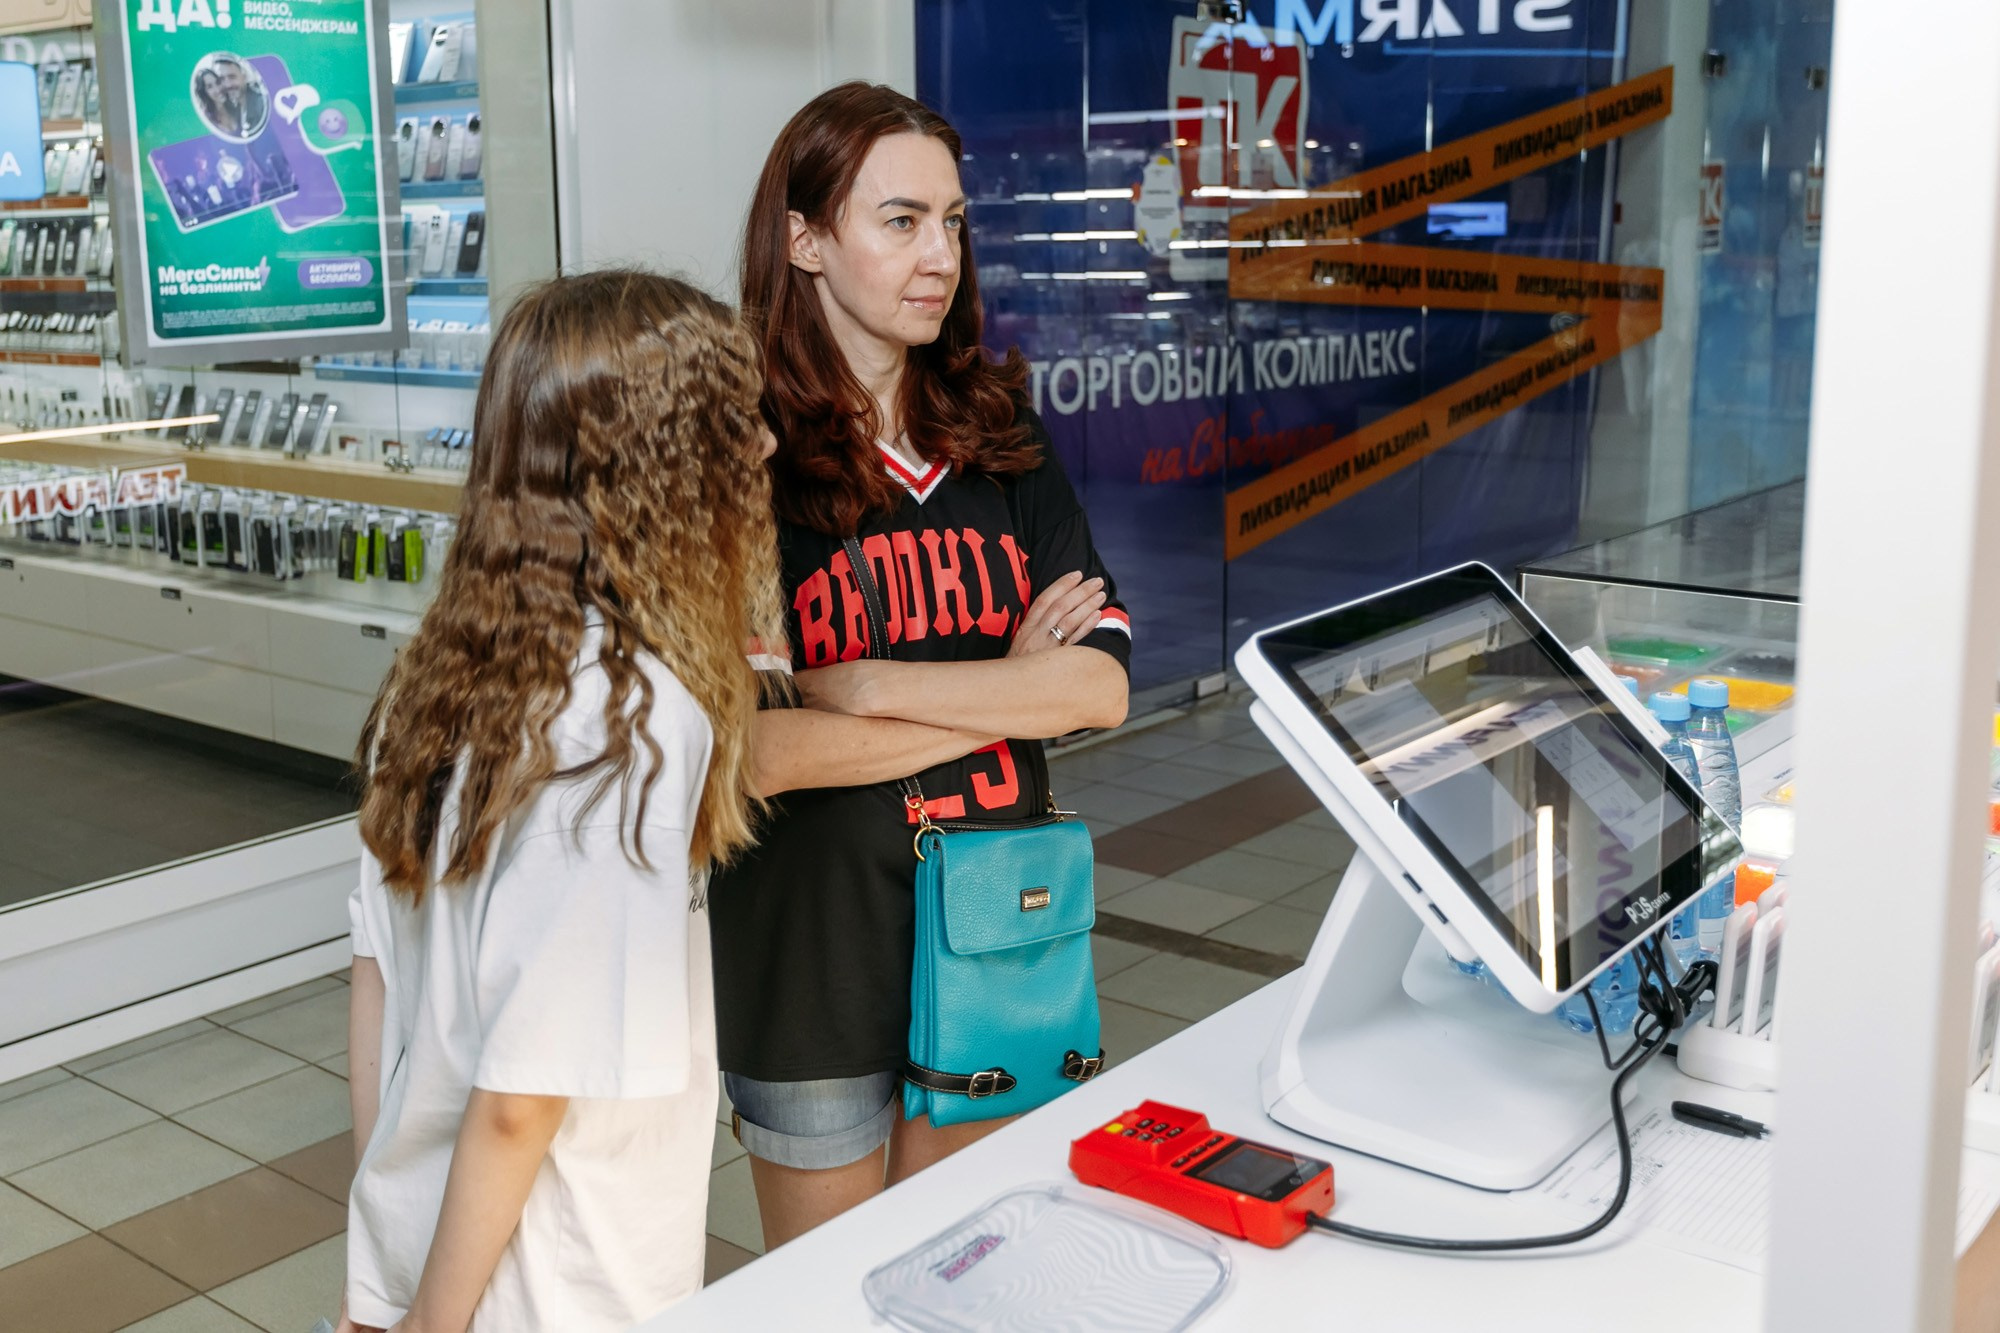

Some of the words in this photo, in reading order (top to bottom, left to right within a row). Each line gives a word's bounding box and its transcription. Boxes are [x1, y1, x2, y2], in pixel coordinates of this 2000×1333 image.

[244, 16, 358, 34] МЕССЕНДЖЕРАМ
[1240, 188, 1378, 263] ЛИКВИДАЦИЯ
[1382, 156, 1472, 211] МАГАЗИНА
[1493, 109, 1593, 170] ЛИКВИДАЦИЯ
[1595, 84, 1664, 131] МАГАЗИНА
[158, 263, 260, 284] МегаСилы
[309, 262, 361, 275] АКТИВИРУЙ
[310, 273, 362, 285] БЕСПЛАТНО
[1311, 258, 1422, 294] ЛИКВИДАЦИЯ
[1426, 267, 1498, 293] МАГАЗИНА
[1515, 273, 1600, 303] ЛИКВИДАЦИЯ
[1603, 279, 1659, 301] МАГАЗИНА
[160, 284, 178, 296] на
[180, 280, 262, 295] безлимиты
[1030, 336, 1244, 416] ТОРГОВЫЙ
[1253, 326, 1416, 391] КОМПЛЕКС
[1446, 368, 1533, 428] ЛИКВИДАЦИЯ
[1535, 336, 1596, 382] МАГАЗИНА
[1141, 446, 1184, 484] на
[1239, 457, 1352, 536] ЛИКВИДАЦИЯ
[1354, 419, 1431, 476] МАГАЗИНА
[793, 527, 1029, 668] BROOKLY
[1624, 896, 1655, 925] POS
[1650, 891, 1672, 909] CENTER
